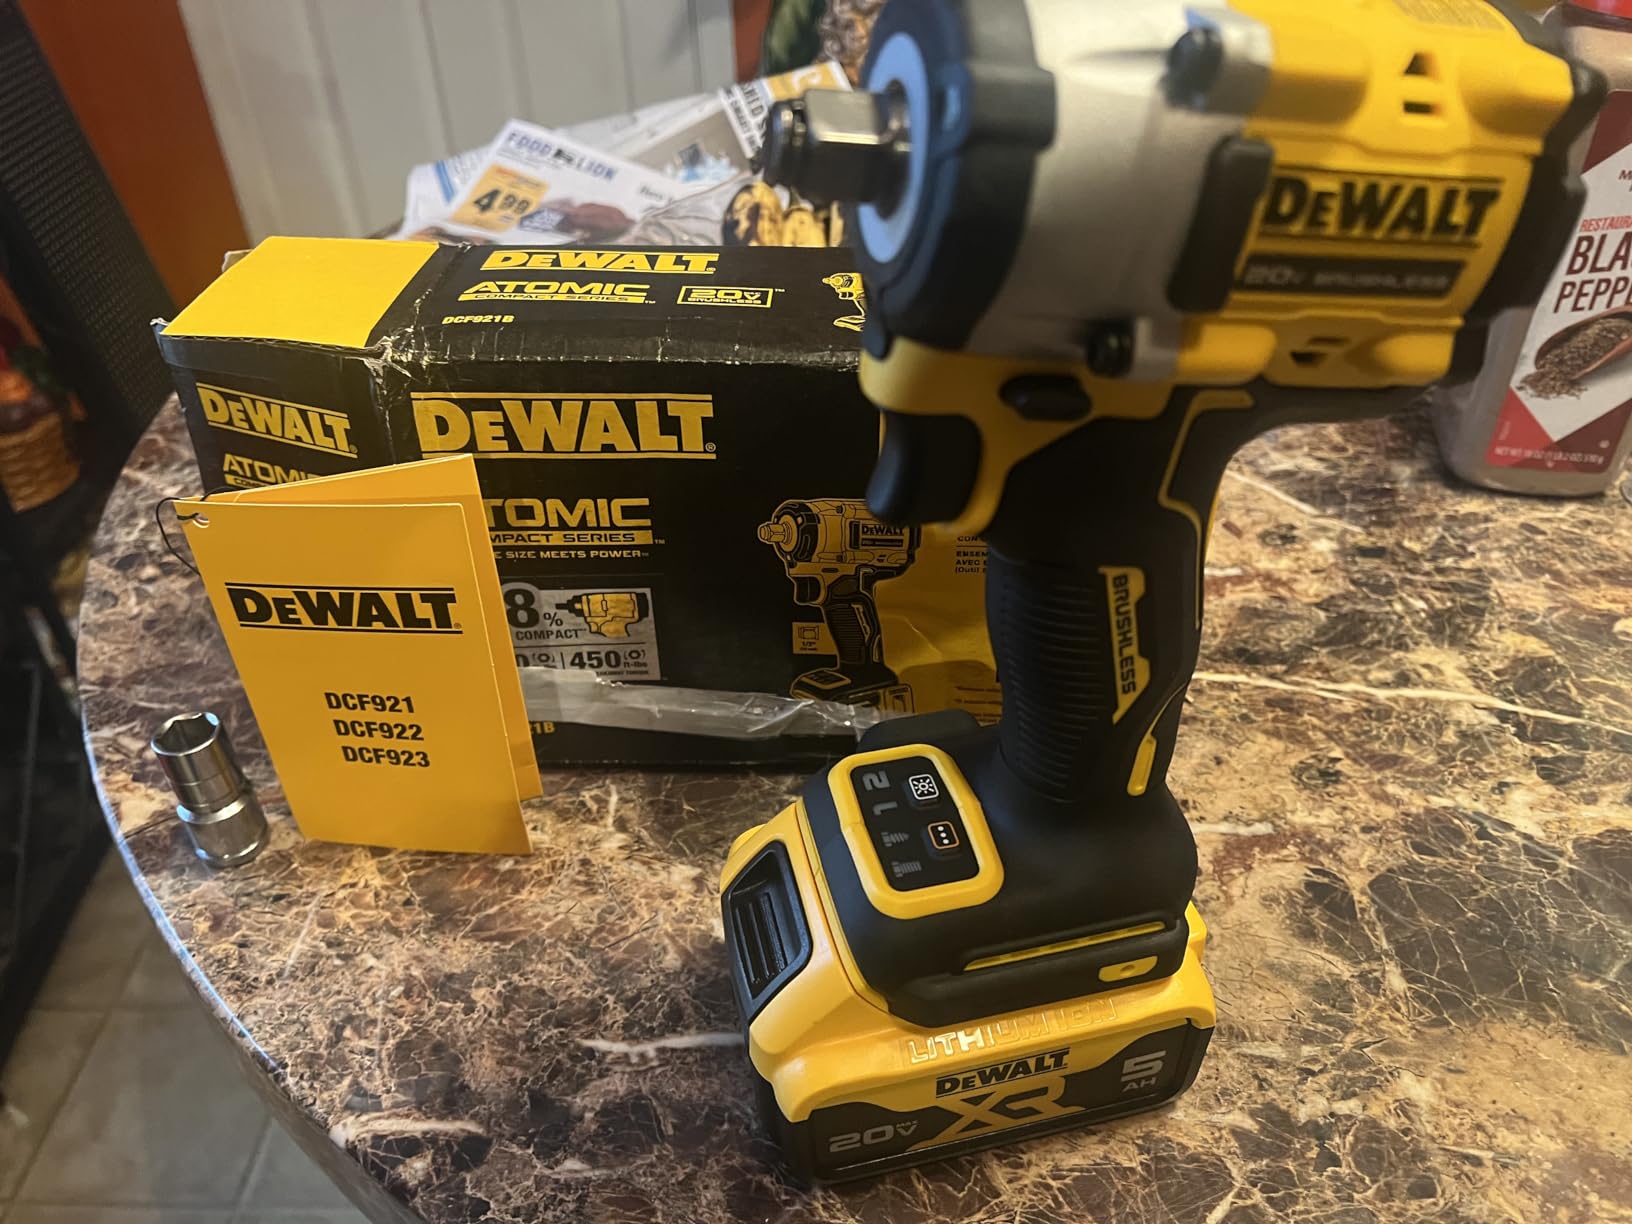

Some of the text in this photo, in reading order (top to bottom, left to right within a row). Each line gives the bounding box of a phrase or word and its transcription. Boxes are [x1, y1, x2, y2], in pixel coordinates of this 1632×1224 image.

[507, 131, 551, 157] FOOD
[575, 156, 617, 181] LION
[1263, 176, 1501, 235] DEWALT
[486, 251, 718, 272] DEWALT
[463, 280, 650, 297] ATOMIC
[442, 315, 514, 325] DCF921B
[197, 386, 352, 453] DEWALT
[412, 399, 714, 454] DEWALT
[484, 497, 652, 528] TOMIC
[490, 532, 636, 545] MPACT SERIES
[505, 550, 537, 559] SIZE
[540, 550, 587, 559] MEETS
[590, 549, 641, 558] POWER
[226, 588, 457, 629] DEWALT
[1112, 574, 1137, 695] BRUSHLESS
[570, 650, 621, 670] 450
[324, 692, 415, 713] DCF921
[333, 719, 424, 741] DCF922
[341, 745, 430, 768] DCF923
[909, 1013, 1049, 1064] LITHIUM
[936, 1051, 1069, 1095] DEWALT
[1121, 1050, 1167, 1082] 5
[1122, 1077, 1157, 1092] AH
